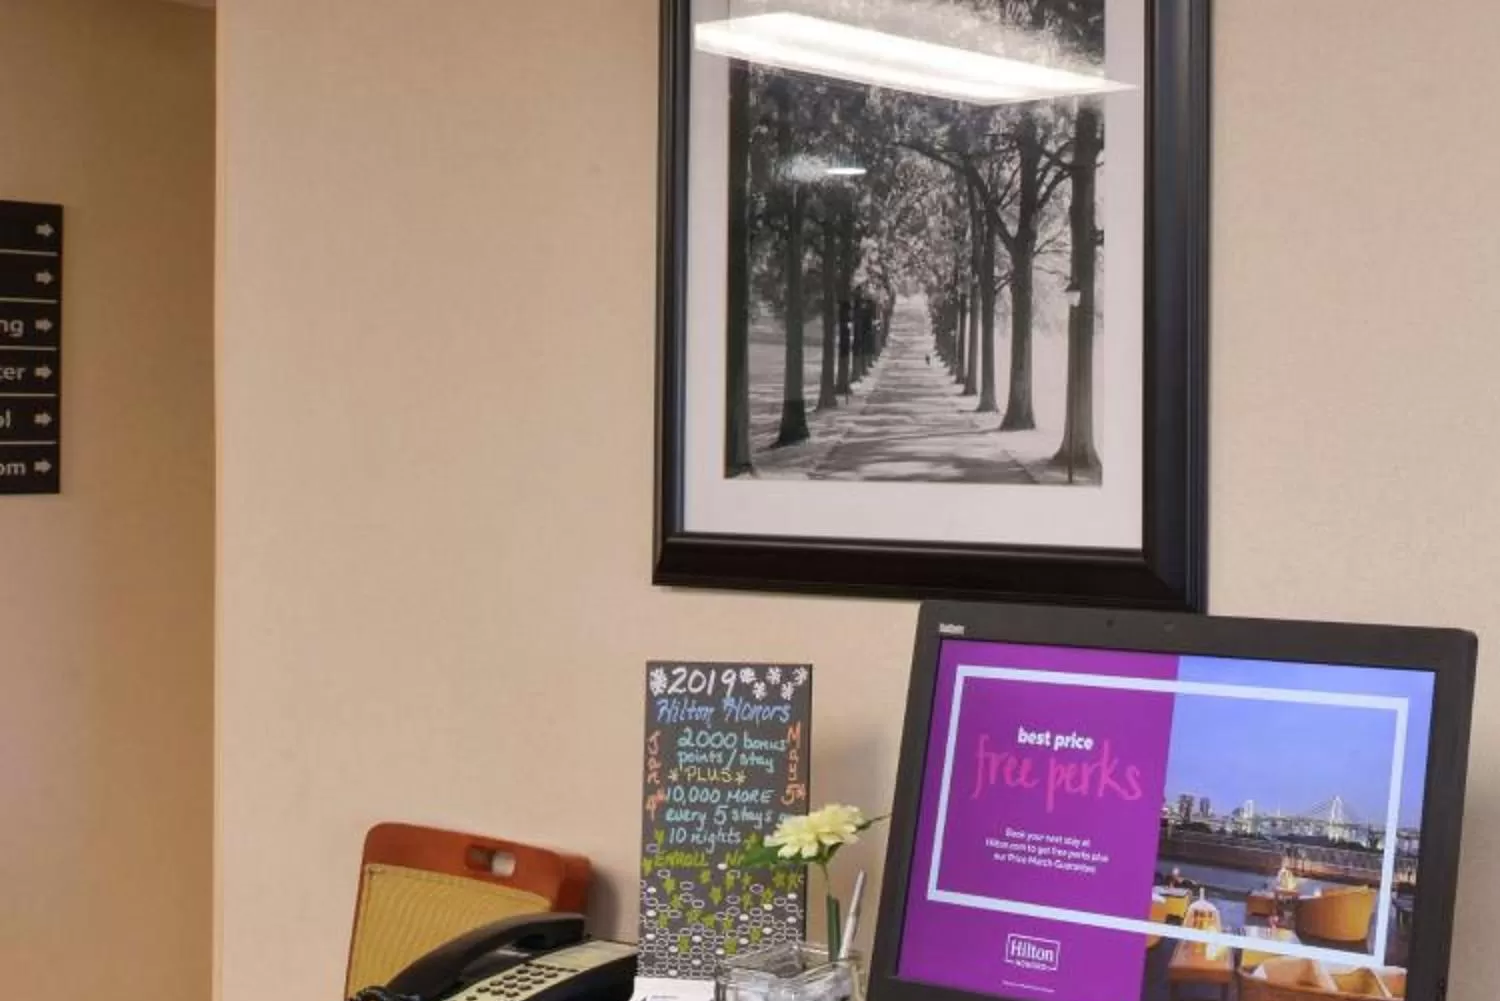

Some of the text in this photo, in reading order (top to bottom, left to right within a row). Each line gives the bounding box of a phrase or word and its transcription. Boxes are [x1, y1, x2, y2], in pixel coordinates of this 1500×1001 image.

[667, 667, 737, 696] 2019
[722, 696, 792, 727] Honors
[677, 727, 738, 749] 2000
[1017, 725, 1094, 751] best price
[972, 733, 1142, 813] free perks
[666, 785, 721, 806] 10,000
[665, 807, 707, 832] every
[713, 804, 729, 825] 5
[731, 806, 773, 830] stays
[669, 826, 741, 854] 10 nights
[1011, 939, 1054, 962] Hilton
